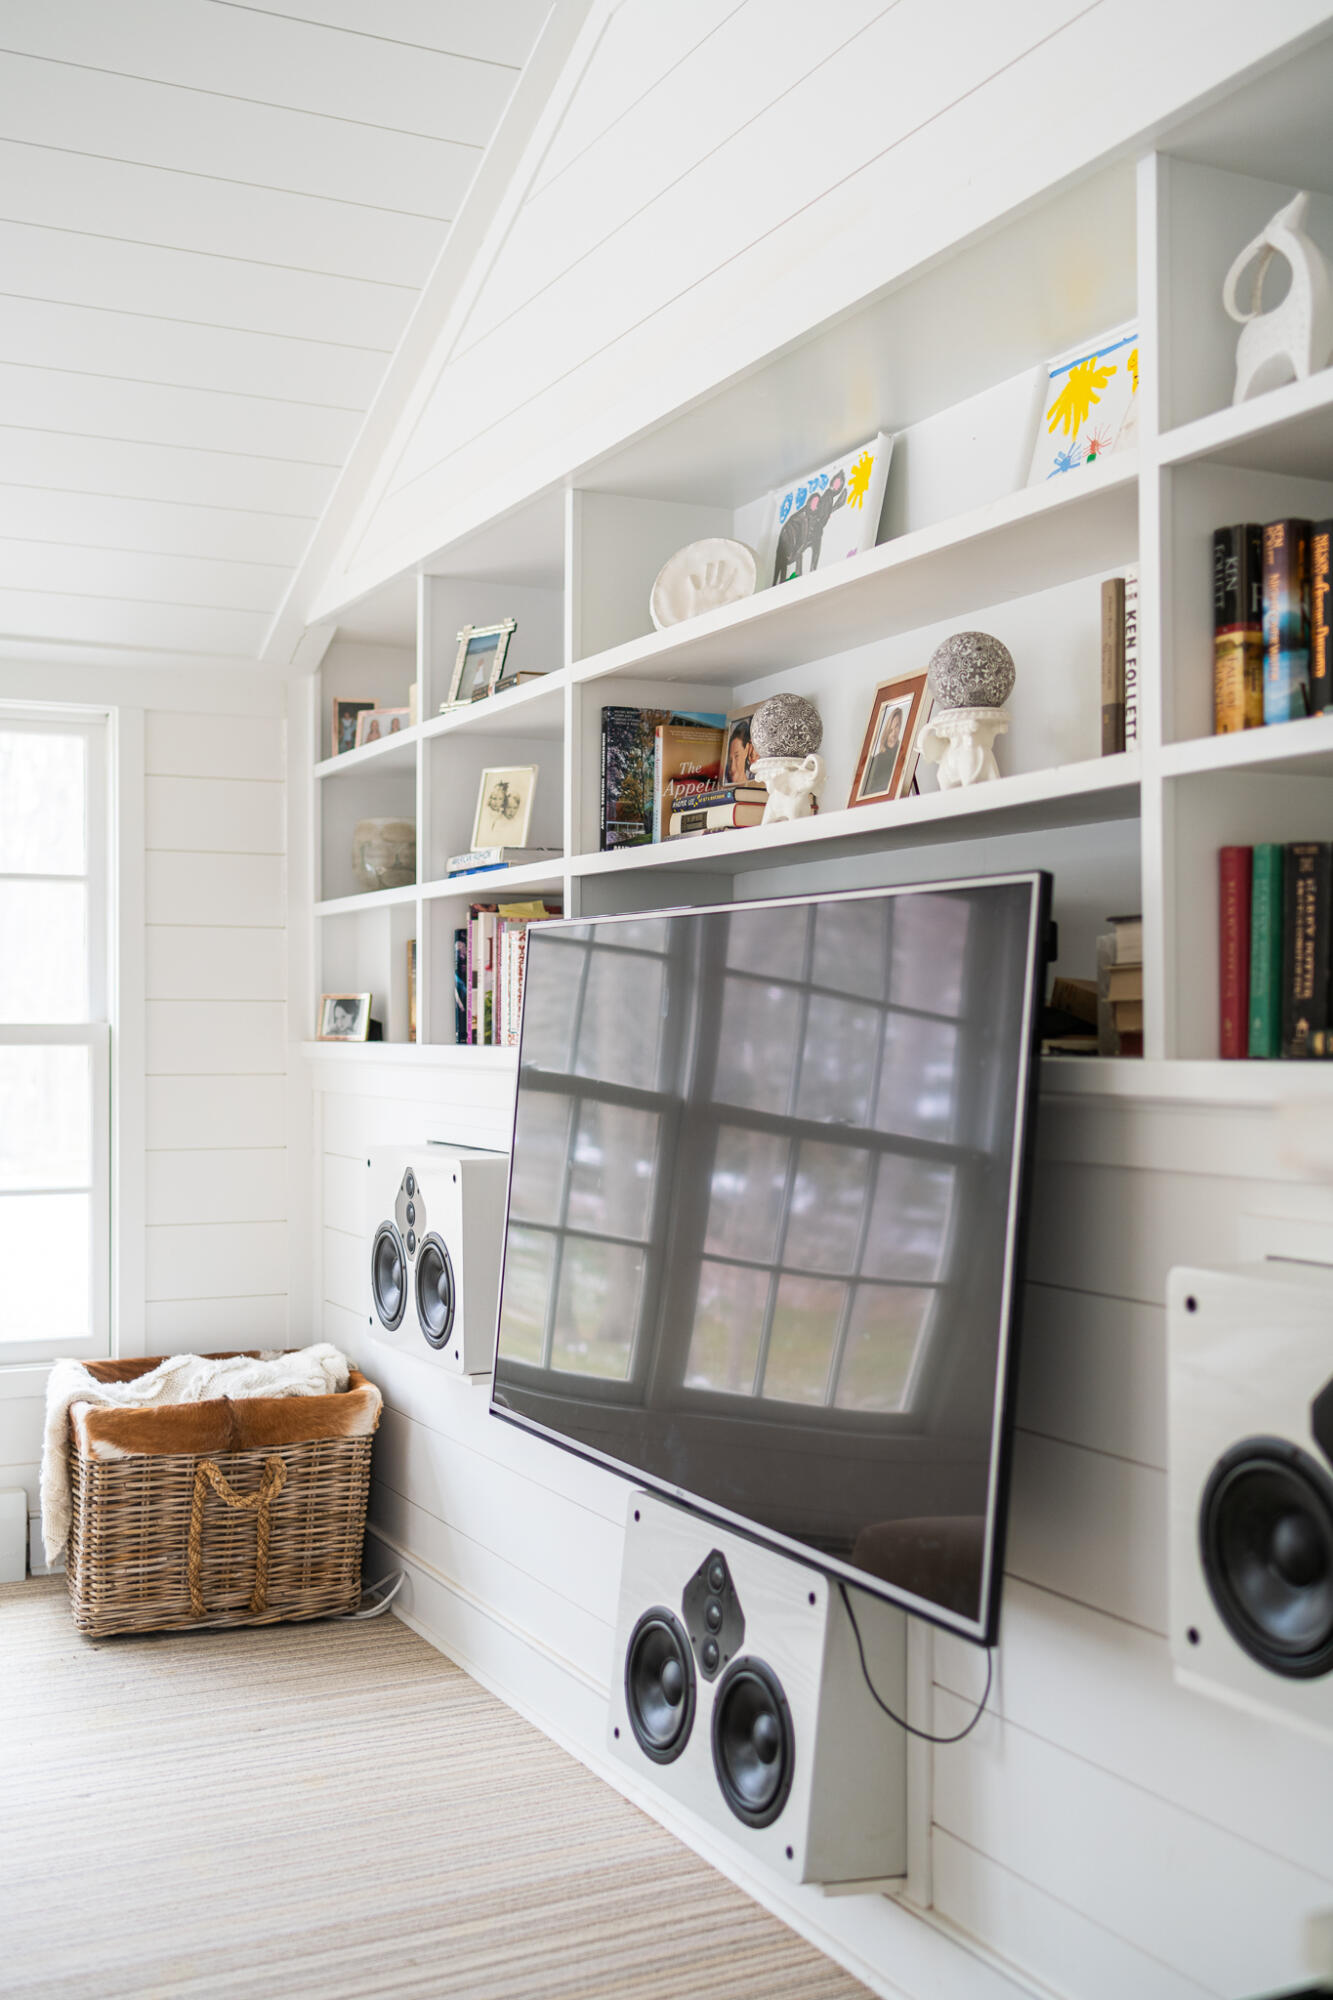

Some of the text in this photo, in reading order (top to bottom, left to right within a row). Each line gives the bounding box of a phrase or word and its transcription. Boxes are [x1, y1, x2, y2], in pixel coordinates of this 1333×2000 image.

[1224, 555, 1239, 591] KEN
[1125, 609, 1137, 649] KEN
[1125, 658, 1137, 740] FOLLETT
[679, 761, 702, 775] The
